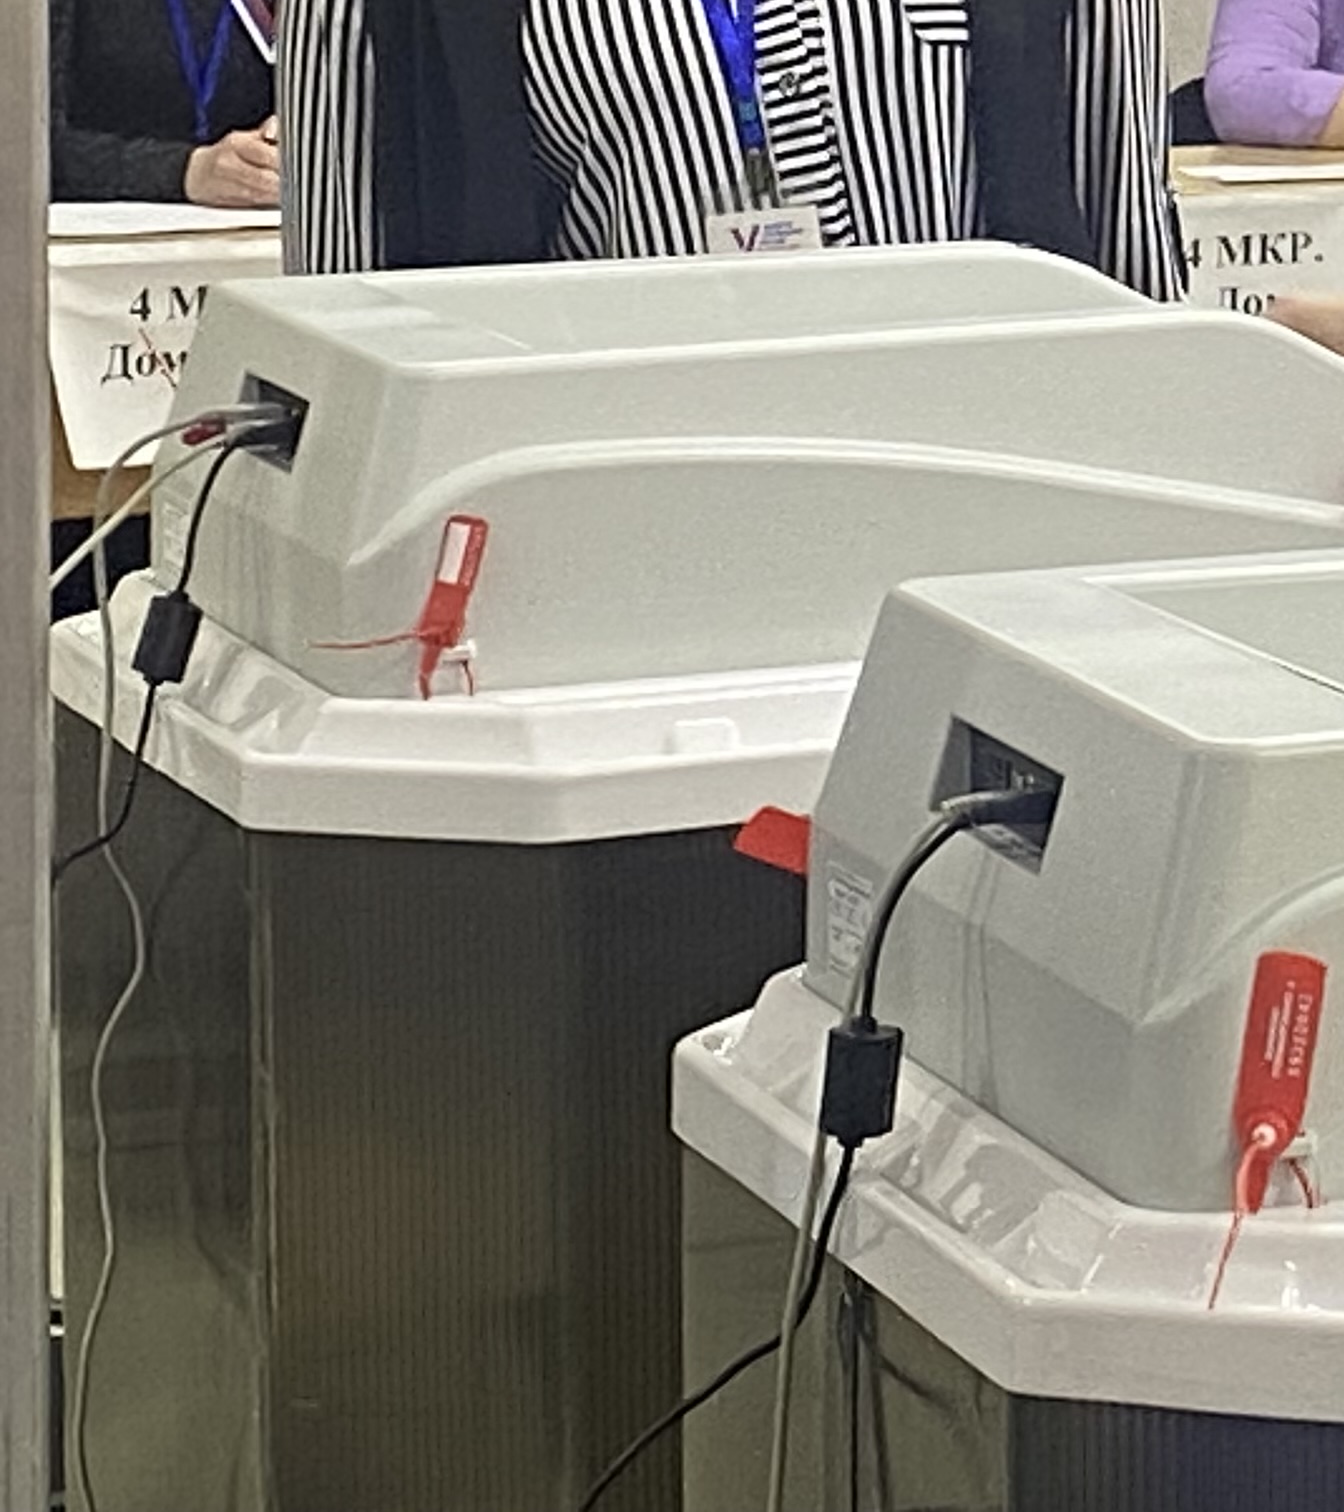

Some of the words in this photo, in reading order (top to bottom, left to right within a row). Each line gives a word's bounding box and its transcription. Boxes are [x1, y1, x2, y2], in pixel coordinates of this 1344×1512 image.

[1186, 238, 1202, 269] 4
[1215, 231, 1324, 269] МКР.
[129, 287, 152, 322] 4
[1218, 286, 1276, 317] До
